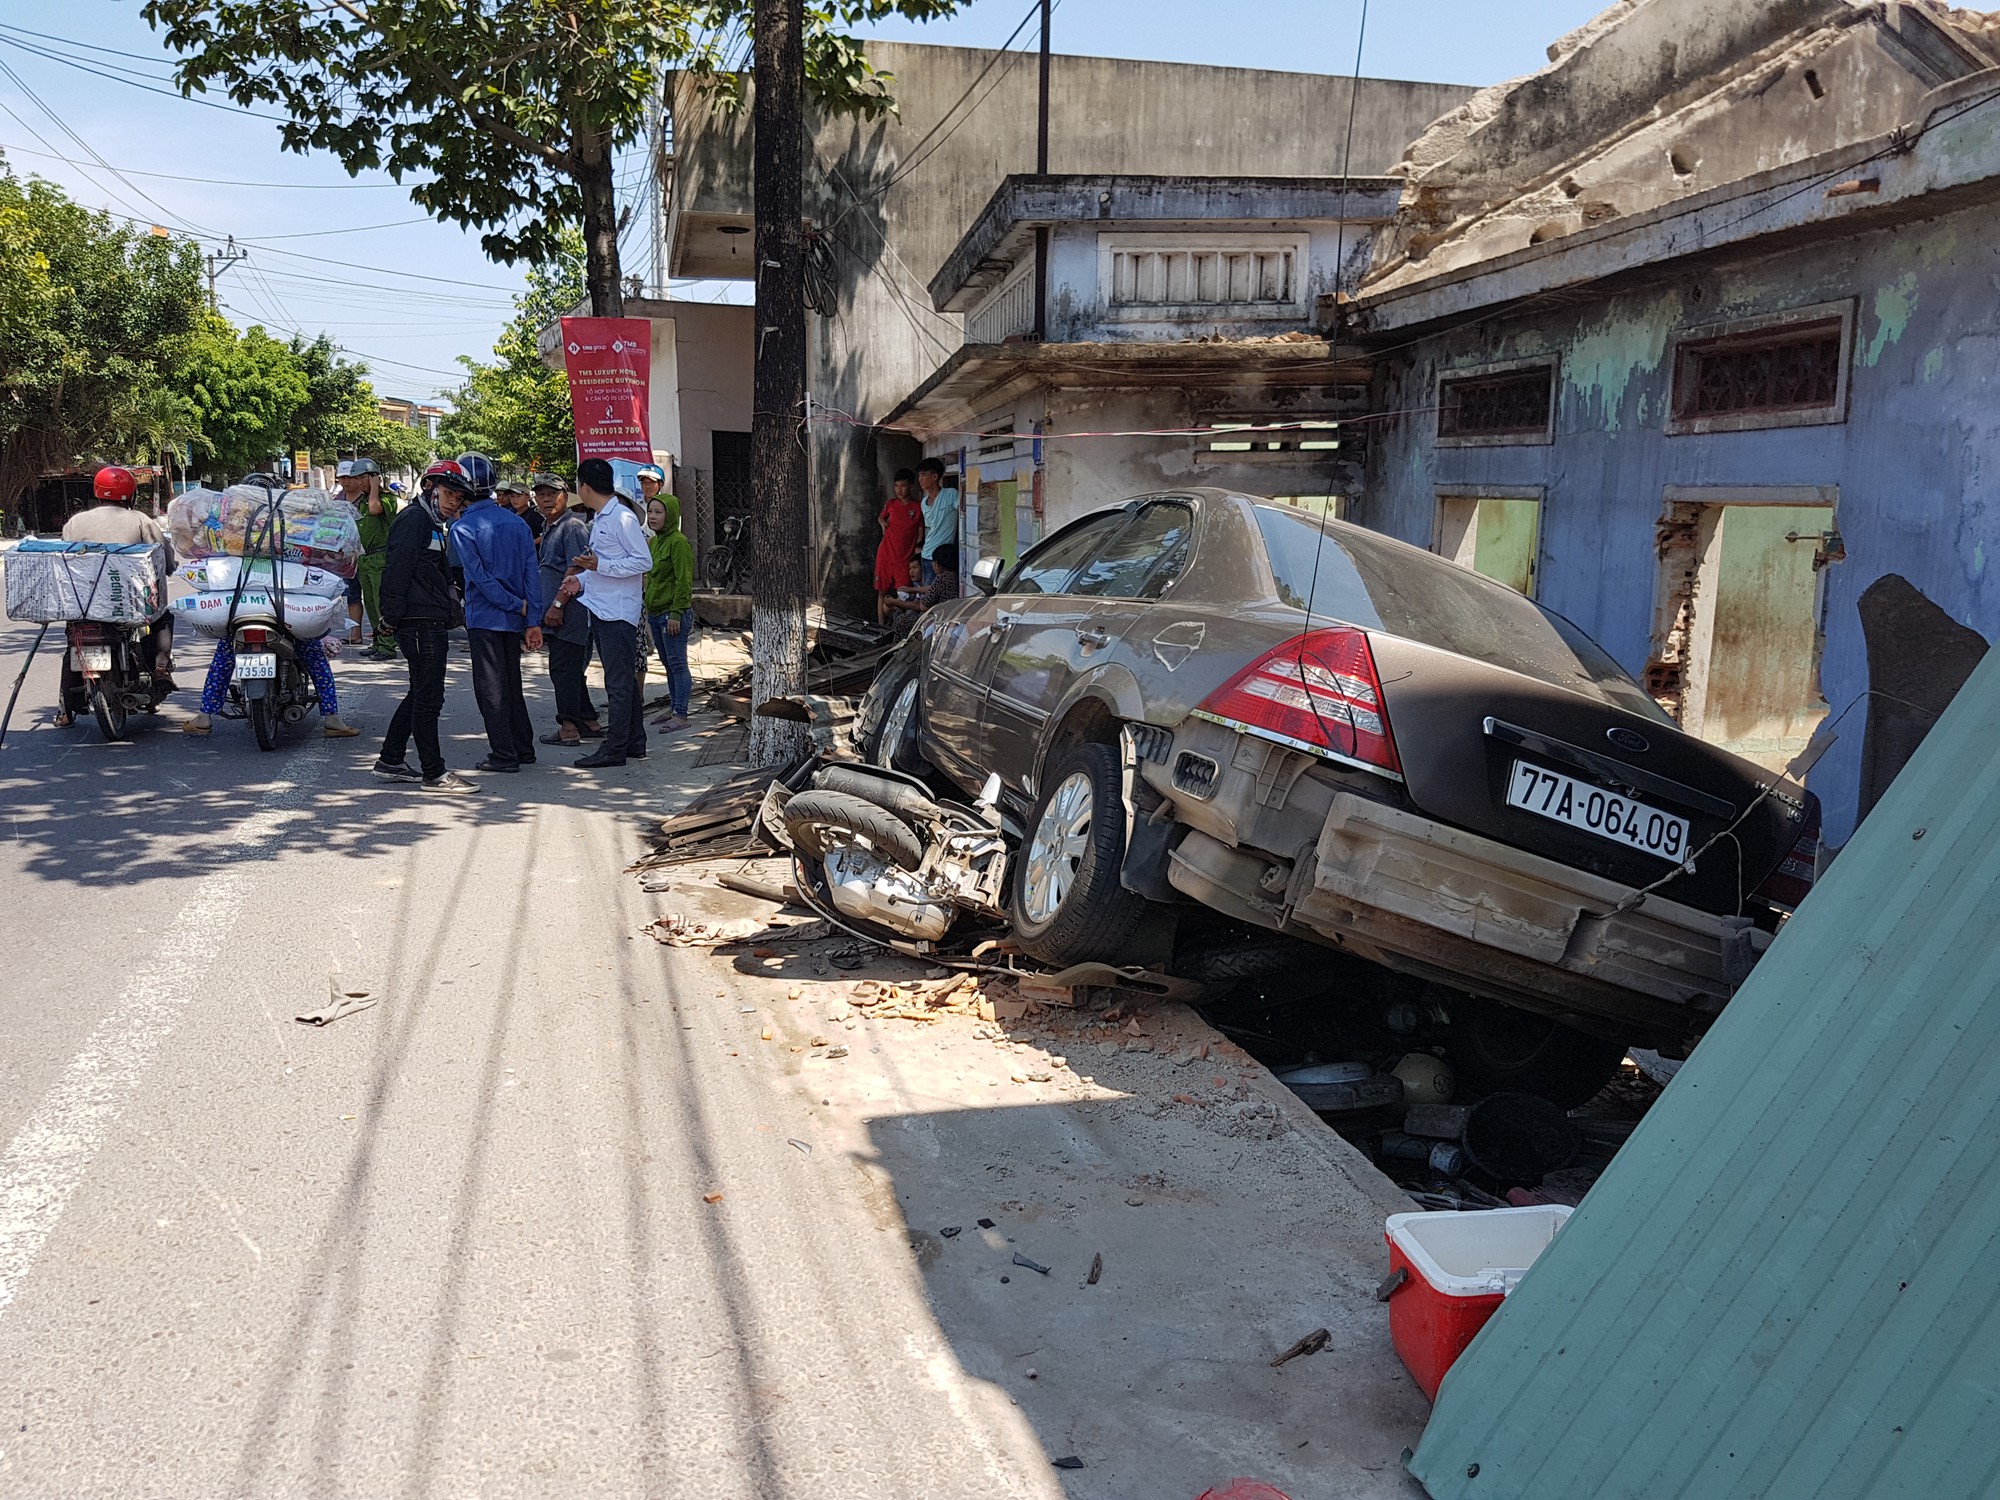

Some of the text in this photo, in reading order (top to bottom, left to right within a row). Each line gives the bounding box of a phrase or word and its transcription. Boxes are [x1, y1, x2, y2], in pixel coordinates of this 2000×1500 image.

[623, 340, 637, 348] TMS
[619, 369, 638, 377] HOTEL
[579, 378, 614, 386] RESIDENCE
[590, 426, 640, 435] 0931 012 789
[200, 598, 222, 611] ĐẠM
[226, 593, 247, 605] PÚ
[250, 594, 266, 605] MỸ
[302, 605, 314, 613] bội
[238, 667, 274, 678] 735.96
[1617, 731, 1641, 747] Ford
[1521, 766, 1683, 856] 77A-064.09
